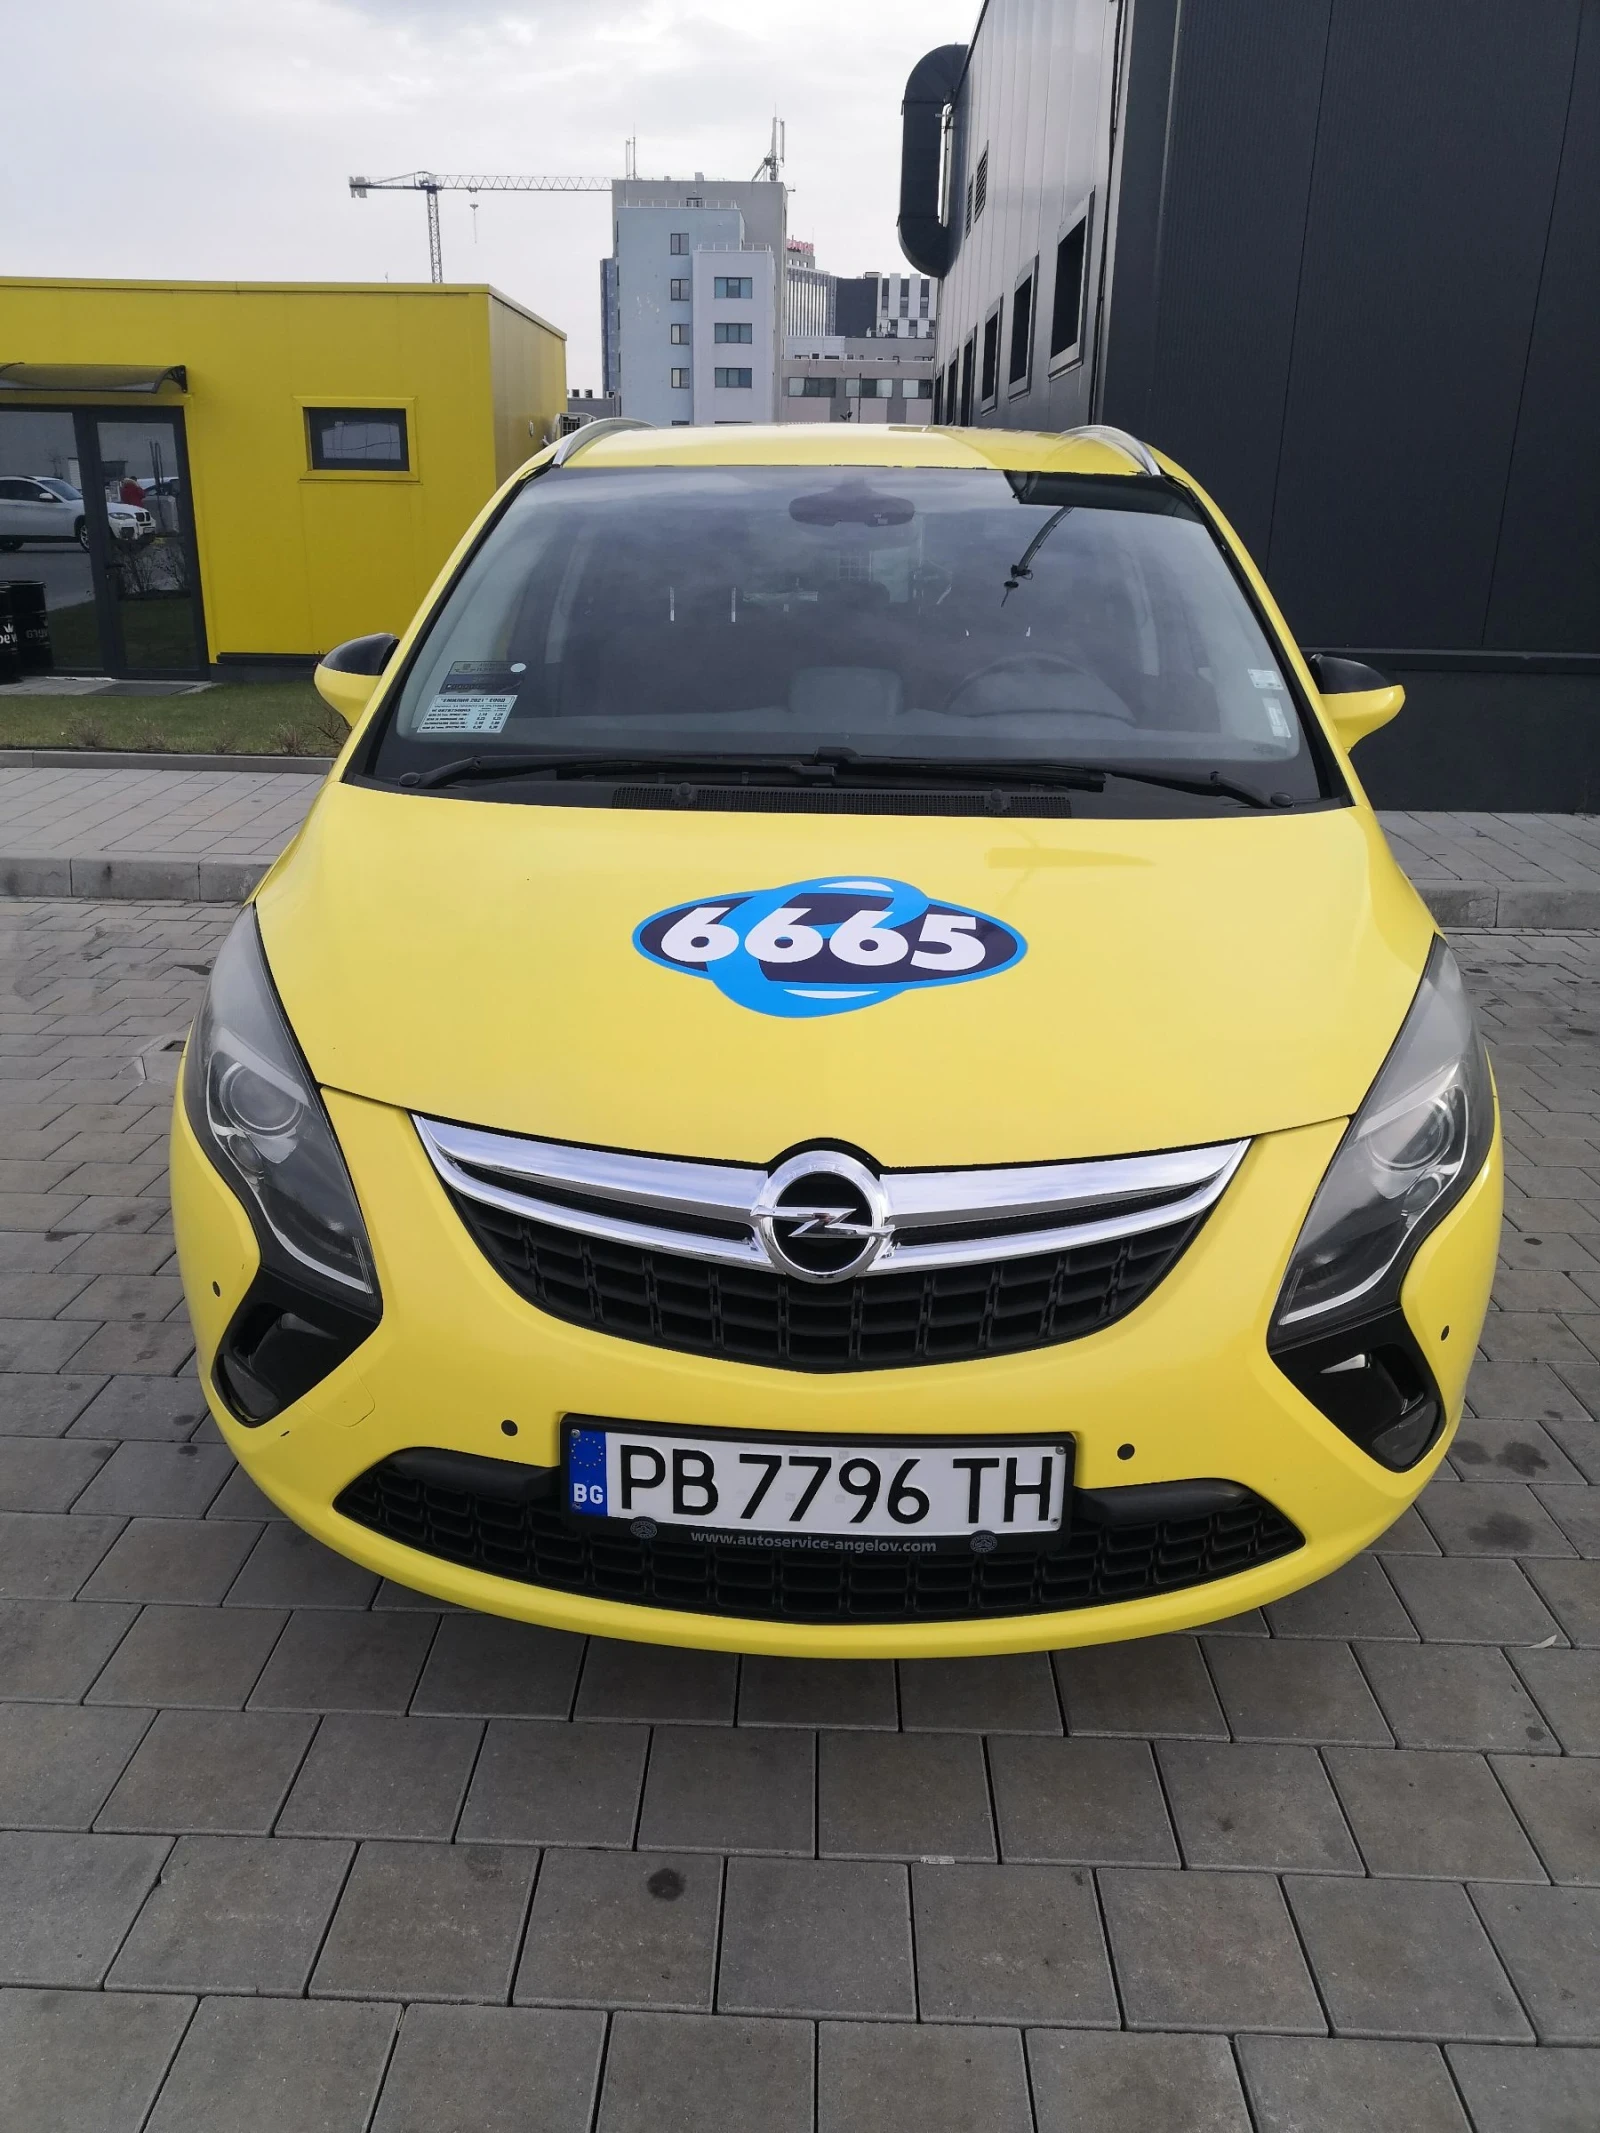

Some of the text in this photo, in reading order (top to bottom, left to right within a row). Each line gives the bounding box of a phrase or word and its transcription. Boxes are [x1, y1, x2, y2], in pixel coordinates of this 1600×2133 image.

[661, 907, 986, 971] 6665
[573, 1482, 604, 1504] BG
[620, 1444, 1053, 1525] PB 7796 TH
[690, 1530, 938, 1554] www.autoservice-angelov.com
